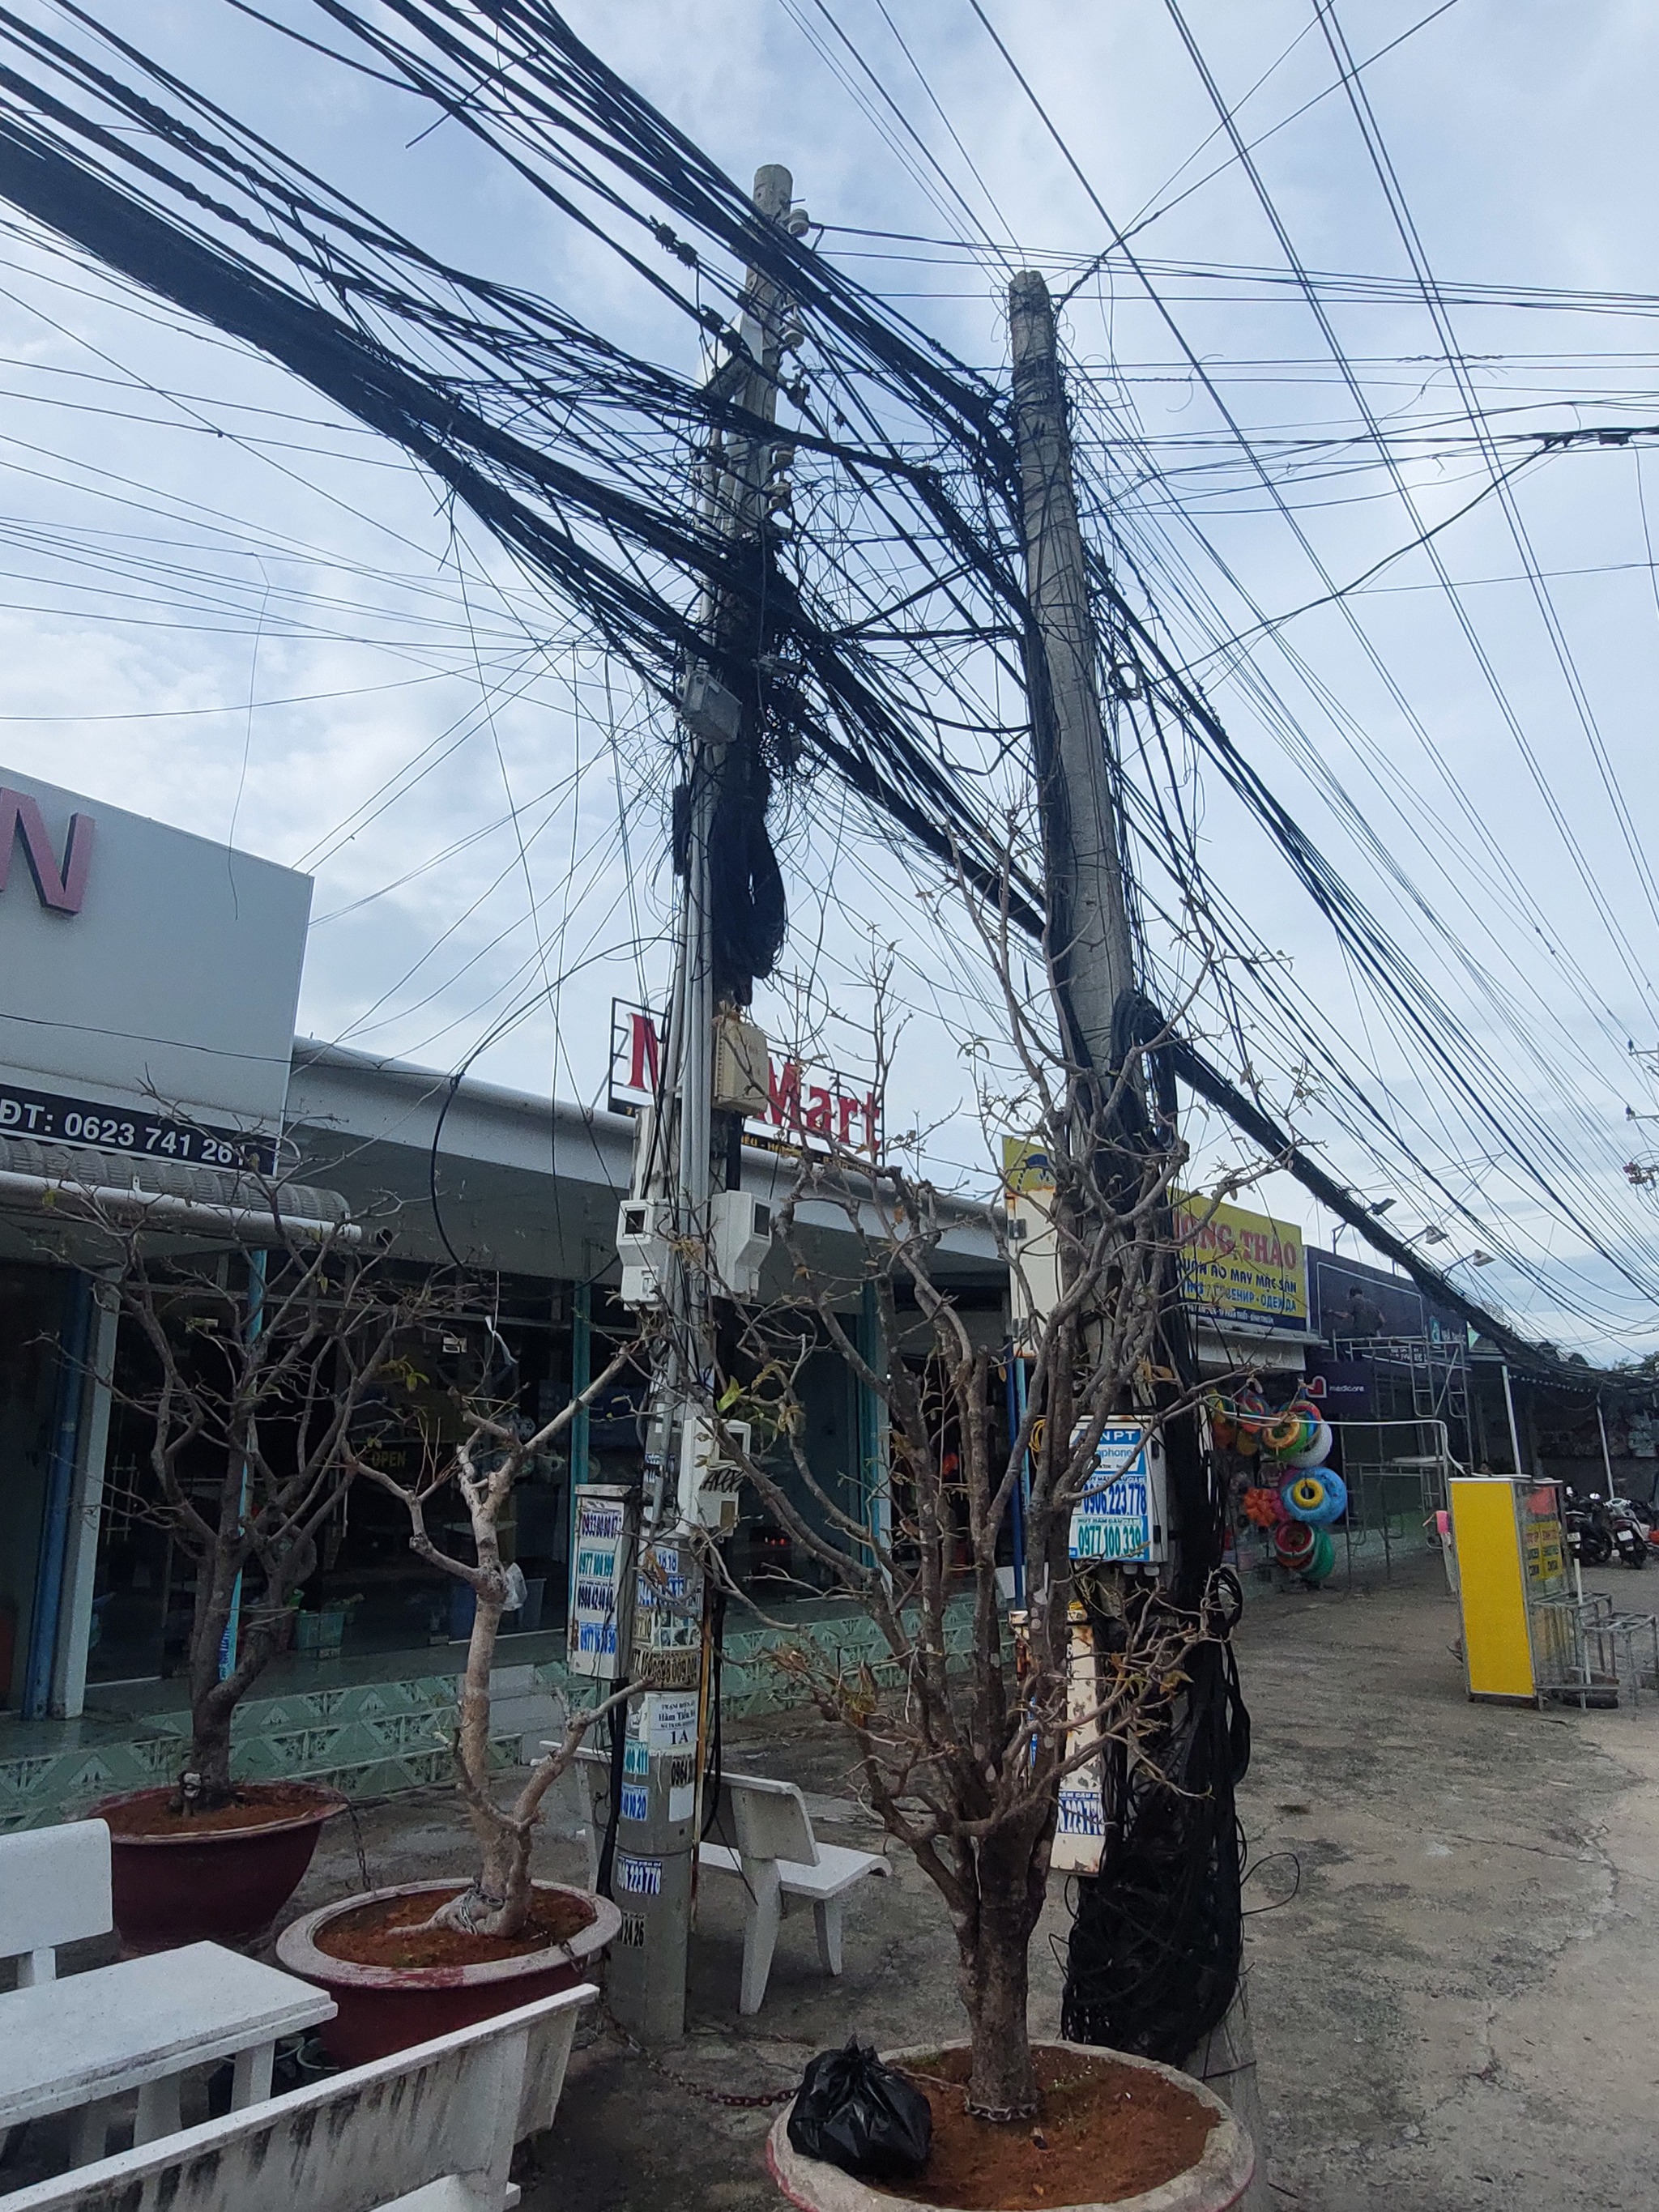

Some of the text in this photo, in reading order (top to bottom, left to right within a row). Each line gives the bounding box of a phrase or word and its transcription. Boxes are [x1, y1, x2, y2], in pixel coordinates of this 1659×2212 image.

[0, 1098, 53, 1132] ĐT:
[65, 1112, 134, 1146] 0623
[145, 1127, 191, 1157] 741
[1230, 1267, 1253, 1286] MAY
[1329, 1383, 1365, 1392] medicare
[1099, 1430, 1137, 1442] NPT
[372, 1451, 406, 1468] OPEN
[1083, 1483, 1147, 1515] 0906.223.778
[1078, 1524, 1141, 1558] 0977100.339
[658, 1712, 676, 1722] Hàm
[671, 1728, 689, 1745] 1A
